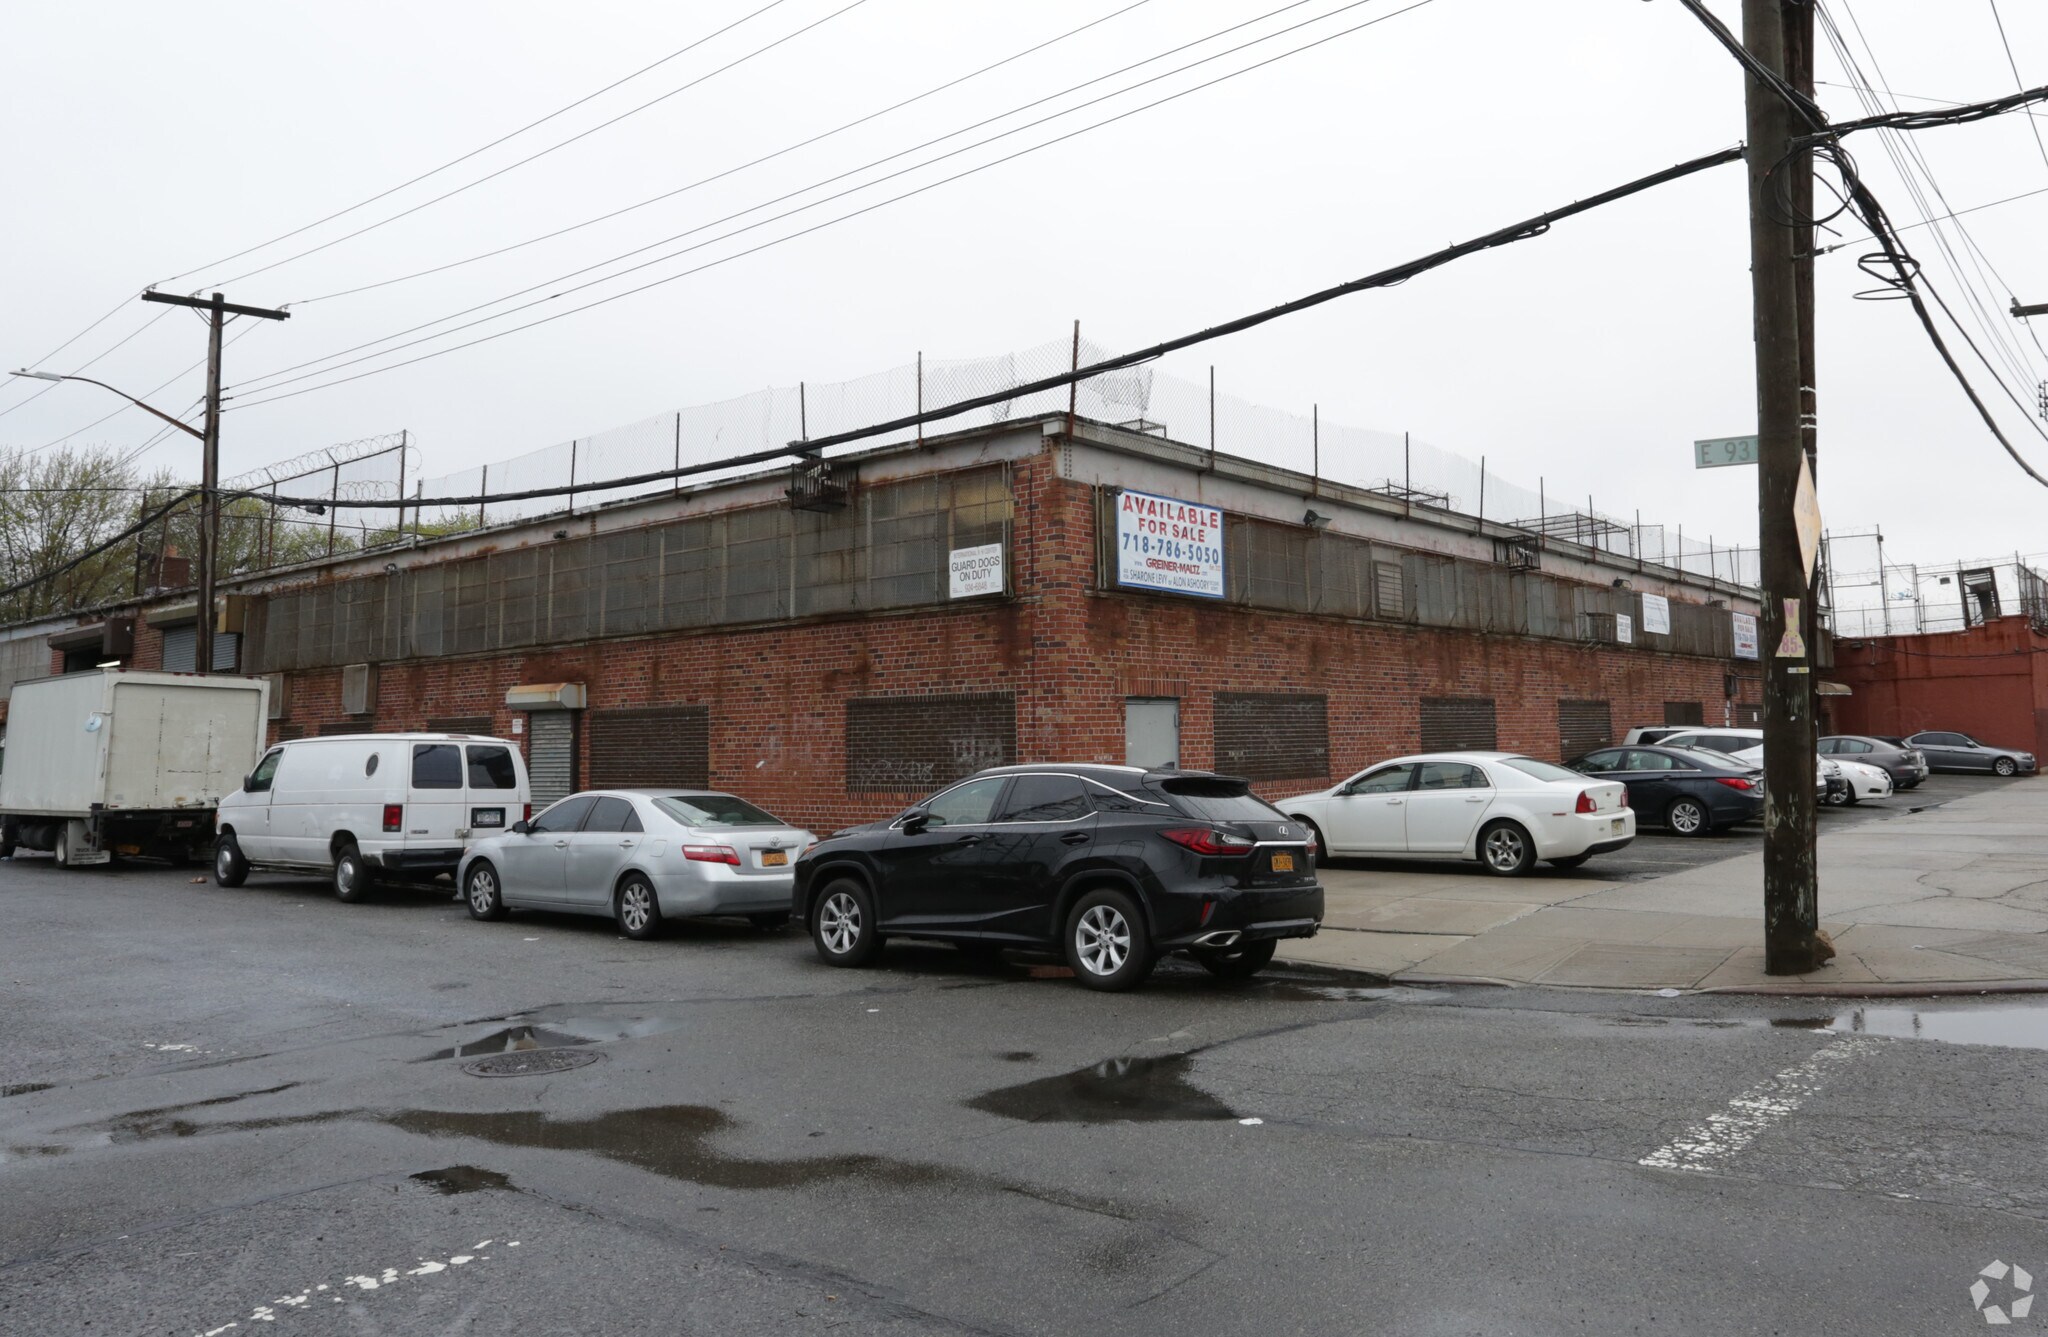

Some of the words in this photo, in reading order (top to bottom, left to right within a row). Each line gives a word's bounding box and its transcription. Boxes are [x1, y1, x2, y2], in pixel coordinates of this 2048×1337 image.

[1701, 443, 1712, 464] E
[1724, 441, 1750, 462] 93
[1122, 495, 1218, 529] AVAILABLE
[1138, 517, 1167, 536] FOR
[1172, 524, 1205, 542] SALE
[1122, 532, 1219, 565] 718-786-5050
[951, 560, 977, 572] GUARD
[978, 555, 1000, 568] DOGS
[1145, 557, 1200, 575] GREINER-MALTZ
[960, 571, 971, 582] ON
[972, 568, 992, 580] DUTY
[1155, 573, 1168, 585] LEVY
[1777, 637, 1803, 653] 85-
